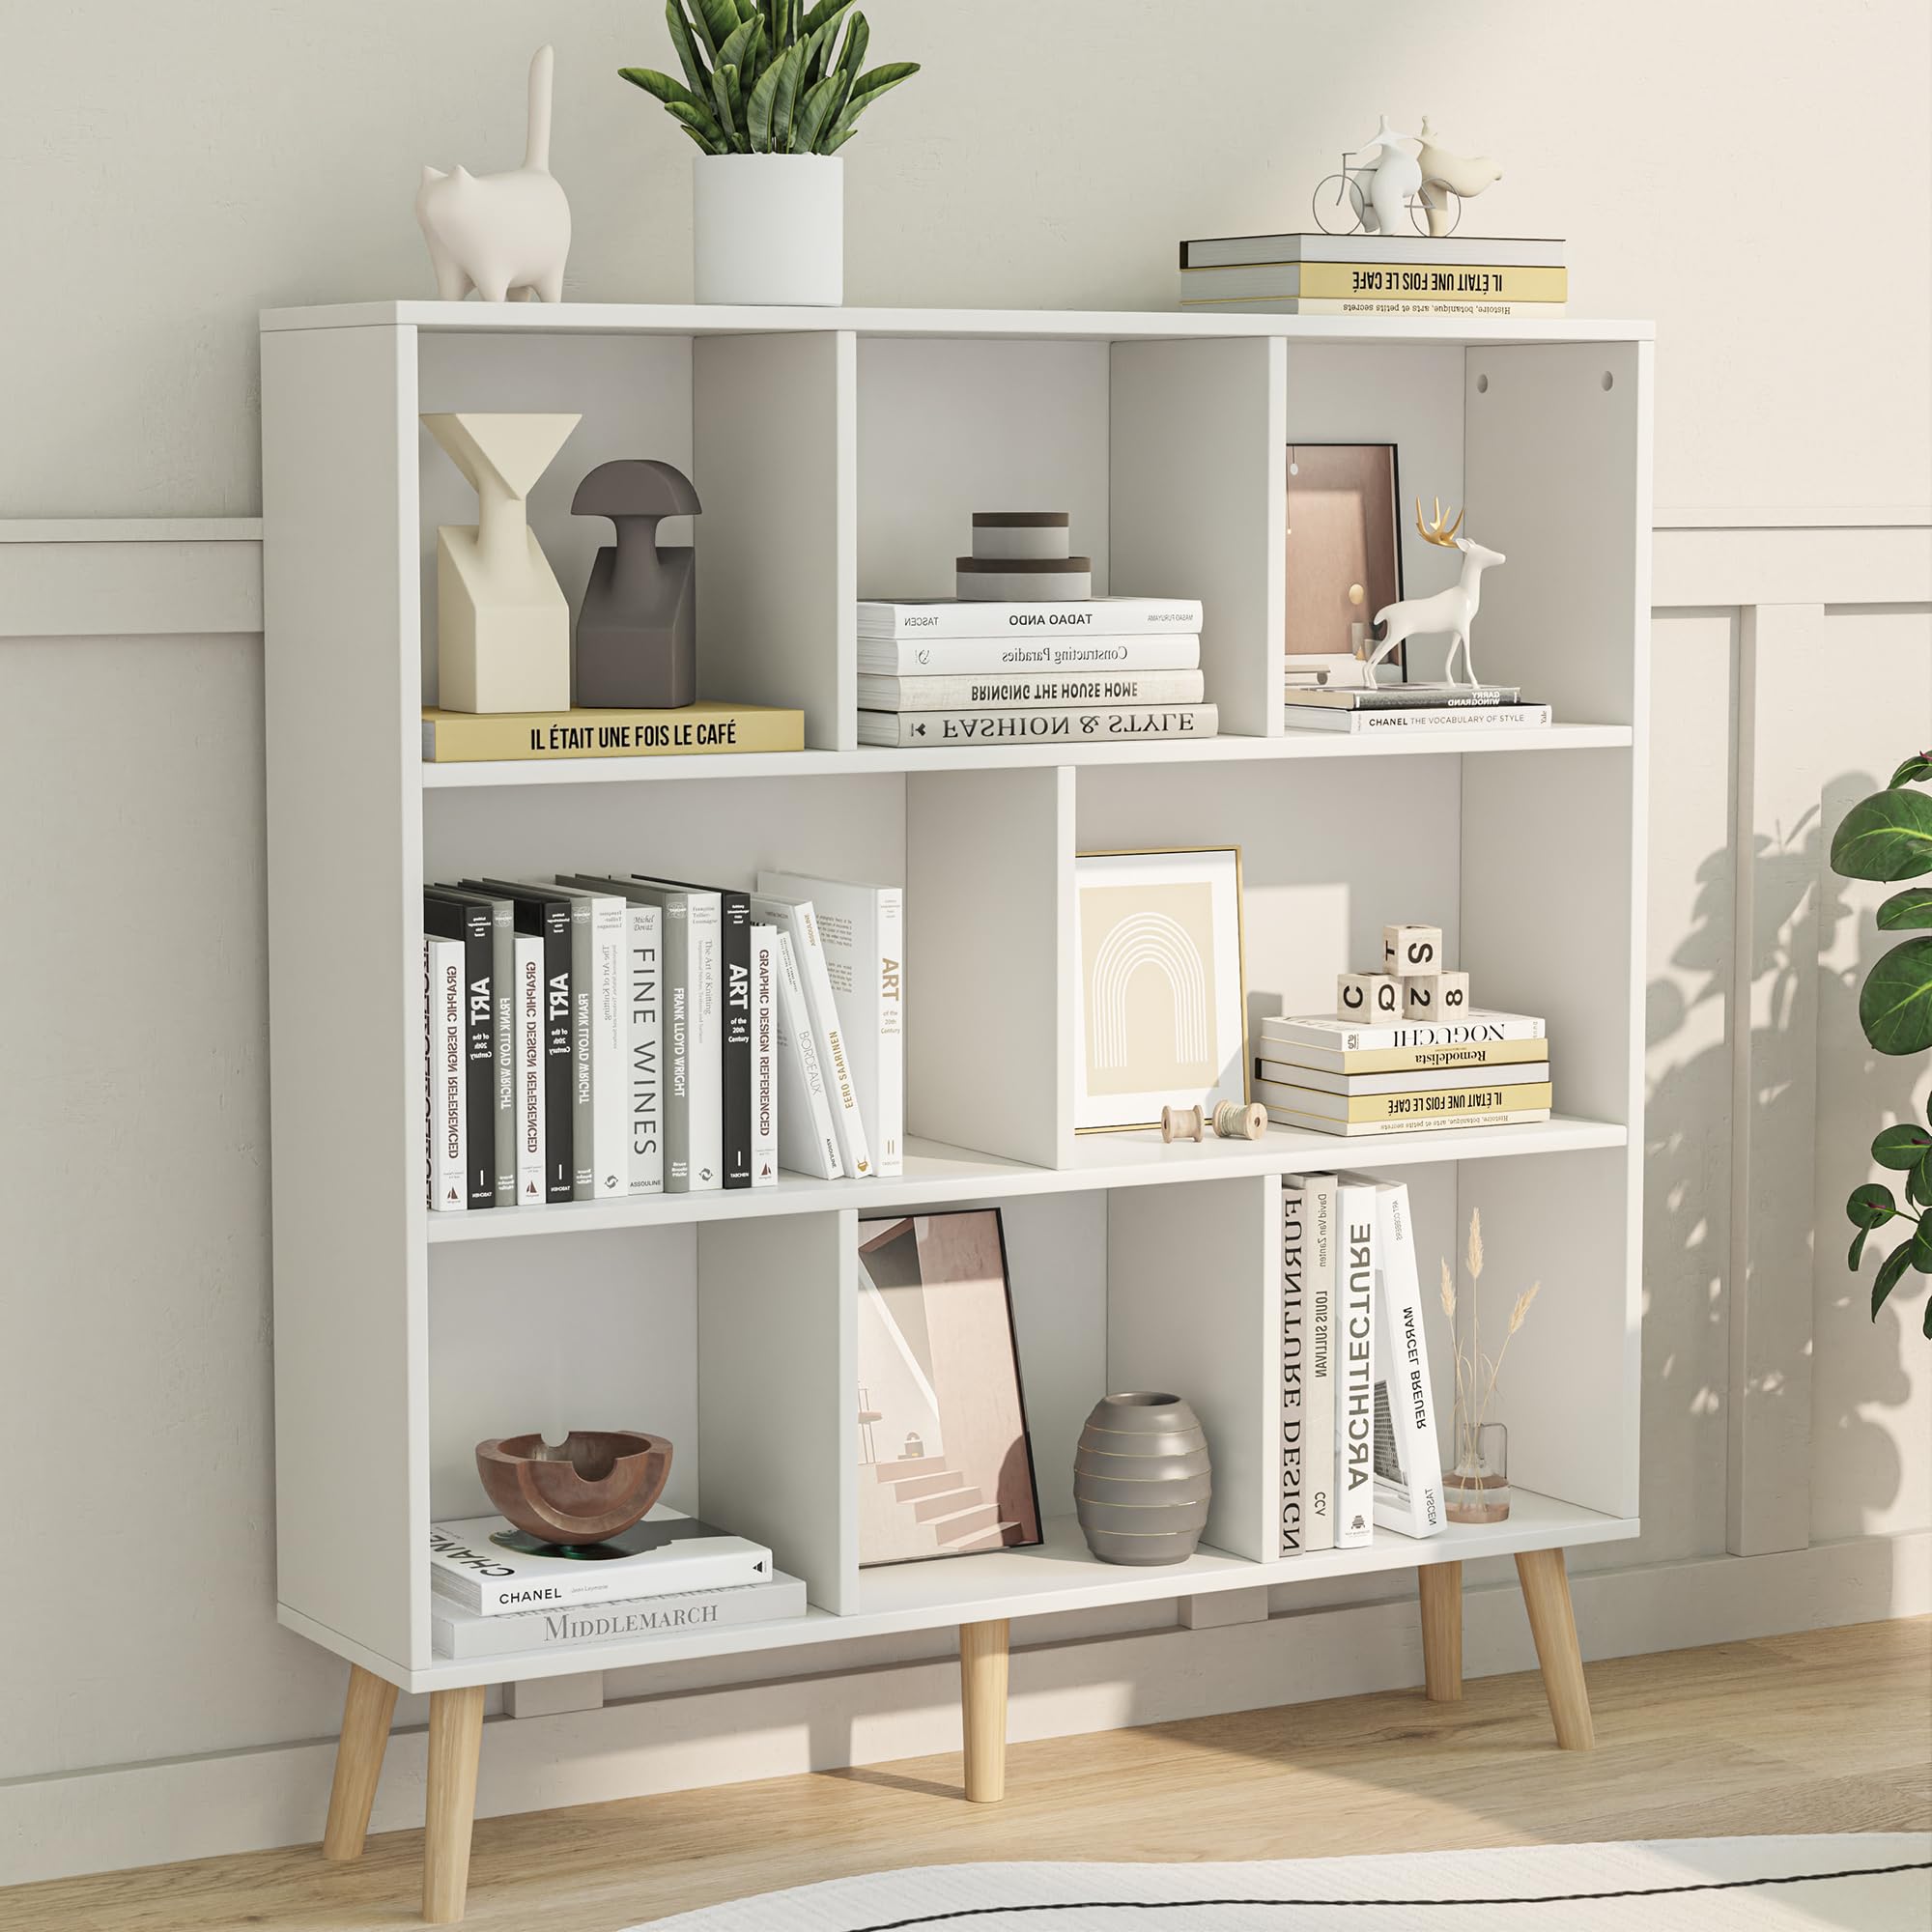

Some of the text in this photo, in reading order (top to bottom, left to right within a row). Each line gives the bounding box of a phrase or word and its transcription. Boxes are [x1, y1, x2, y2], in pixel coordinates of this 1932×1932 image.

[1352, 271, 1502, 295] IL ÉTAIT UNE FOIS LE CAFÉ
[1343, 303, 1374, 312] secrets
[1376, 303, 1400, 312] petits
[1432, 304, 1474, 314] botanique,
[1476, 306, 1511, 315] Histoire,
[1368, 718, 1408, 726] CHANEL
[1428, 715, 1484, 724] VOCABULARY
[1499, 714, 1524, 723] STYLE
[530, 719, 736, 750] IL ÉTAIT UNE FOIS LE CAFÉ
[1407, 942, 1434, 964] S
[728, 964, 748, 1009] ART
[759, 949, 770, 1004] GRAPHIC
[882, 958, 899, 1002] ART
[703, 982, 713, 1015] Knitting
[1343, 984, 1363, 1009] C
[1378, 983, 1395, 1012] Q
[1410, 987, 1431, 1007] 2
[1445, 989, 1463, 1007] 8
[674, 987, 686, 1097] FRANK LLOYD WRIGHT
[728, 1035, 750, 1043] Century
[759, 1008, 770, 1053] DESIGN
[1393, 1023, 1505, 1047] NOGUCHI
[633, 949, 657, 1155] FINE WINES
[799, 1031, 822, 1095] BORDEAUX
[1415, 1049, 1486, 1065] Remodelista
[829, 1031, 854, 1109] EERO SAARINEN
[759, 1057, 771, 1136] REFERENCED
[1387, 1092, 1502, 1117] IL ÉTAIT UNE FOIS LE CAFÉ
[498, 1588, 562, 1605] CHANEL
[544, 1605, 719, 1641] MIDDLEMARCH
